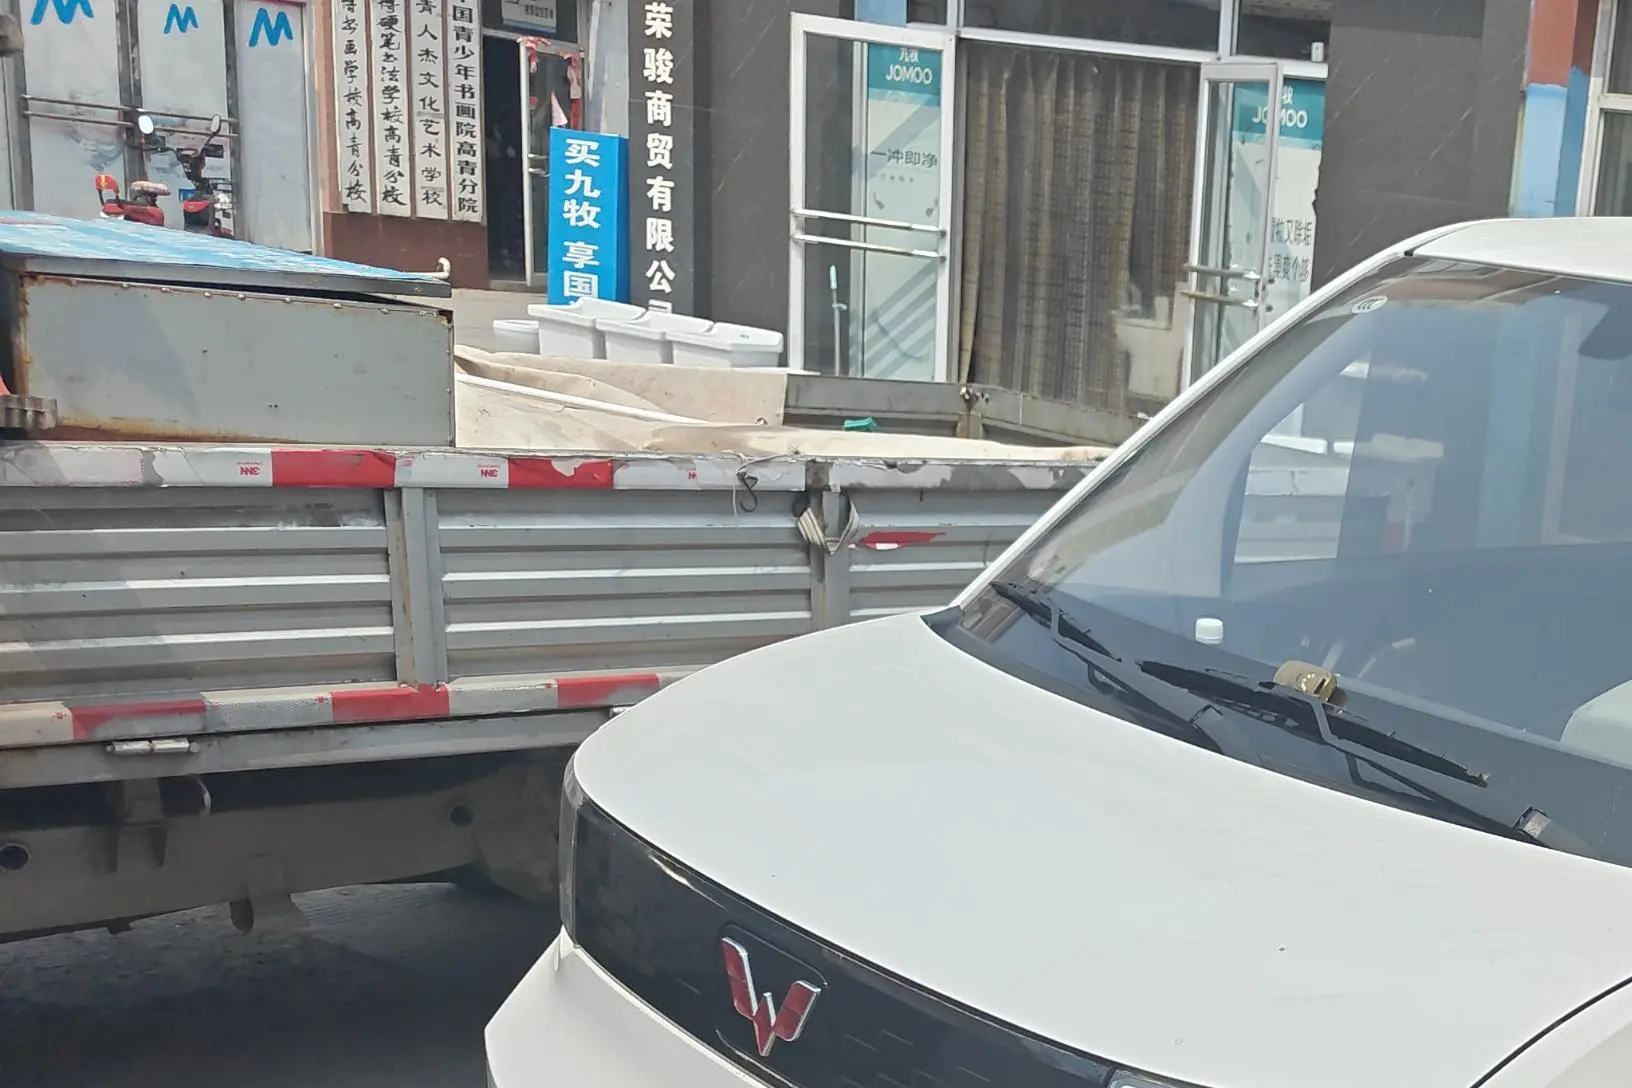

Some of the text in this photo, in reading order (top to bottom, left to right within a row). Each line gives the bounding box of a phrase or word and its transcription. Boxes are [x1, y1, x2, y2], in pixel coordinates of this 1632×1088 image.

[452, 0, 479, 213] 国青少年书画院高青分院
[885, 63, 933, 85] JOMOO
[870, 147, 938, 169] 一冲即净
[562, 138, 602, 305] 买九牧 享国
